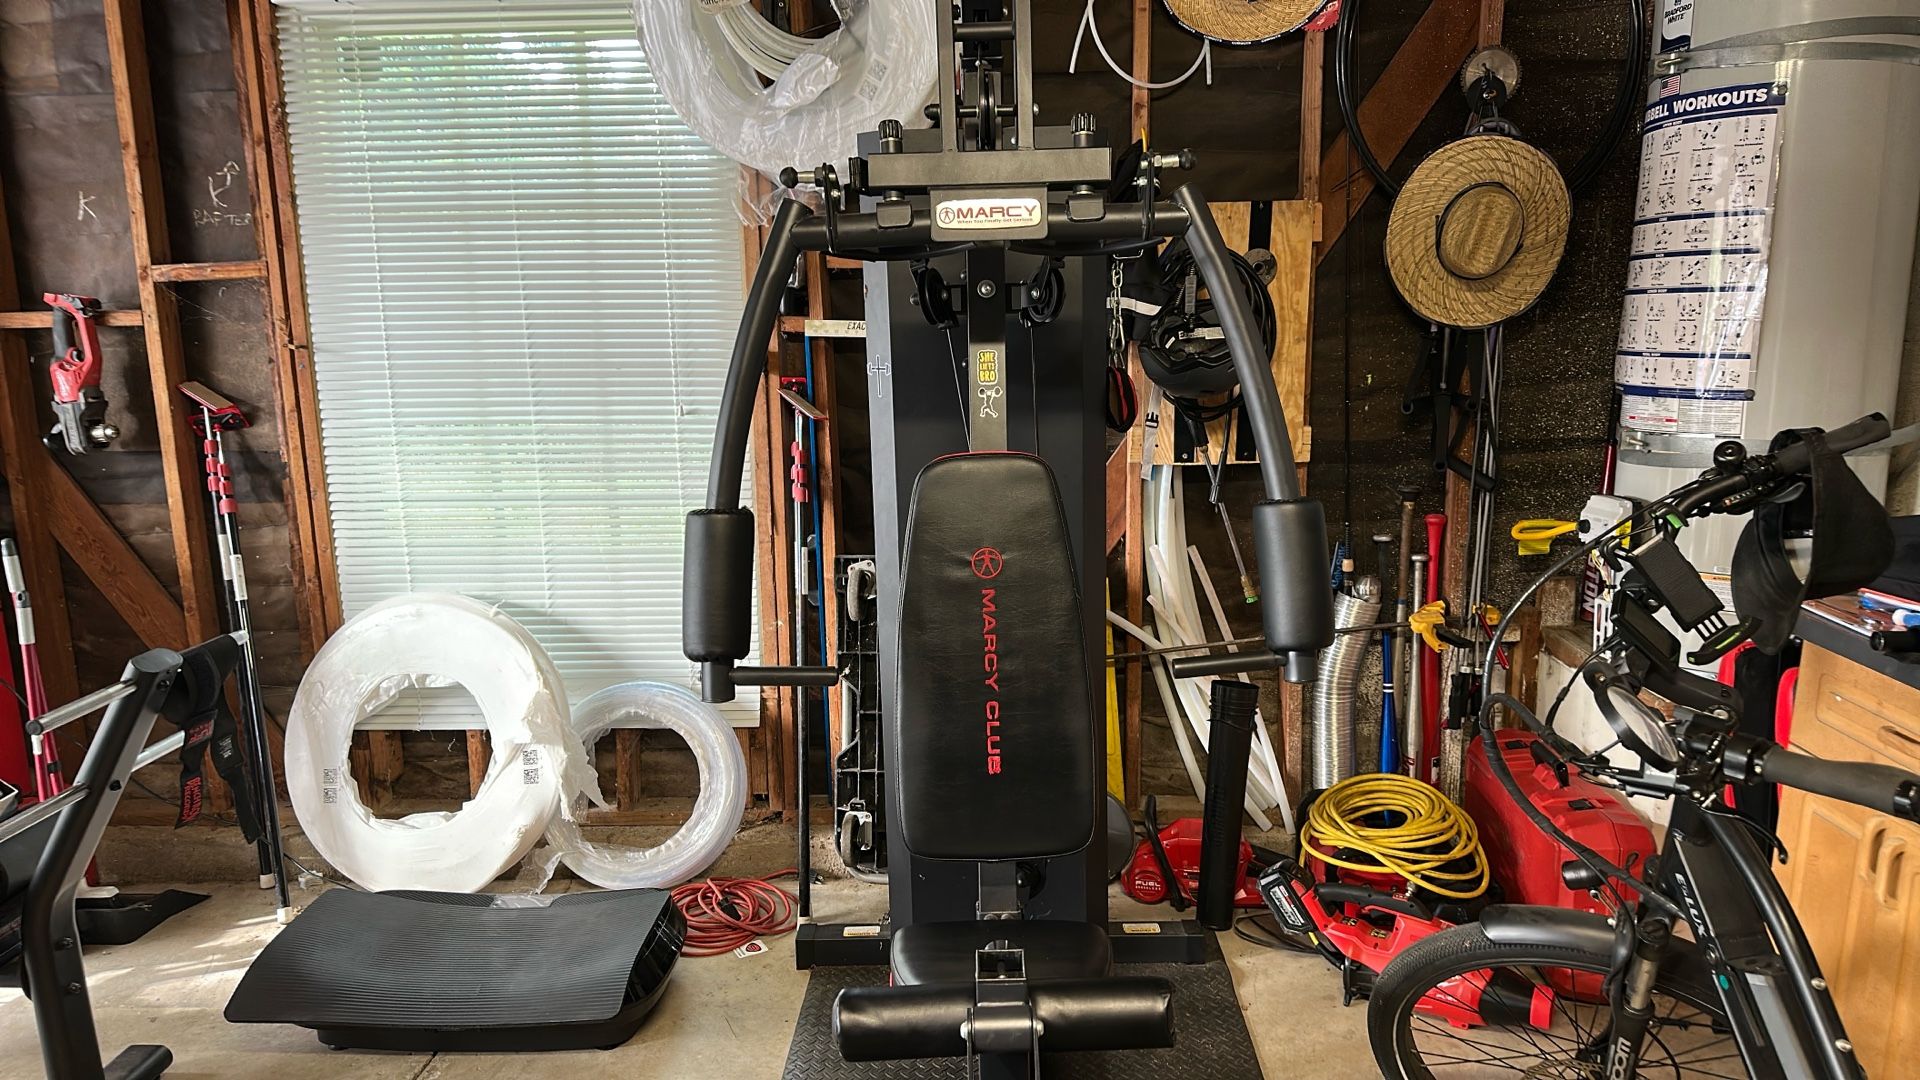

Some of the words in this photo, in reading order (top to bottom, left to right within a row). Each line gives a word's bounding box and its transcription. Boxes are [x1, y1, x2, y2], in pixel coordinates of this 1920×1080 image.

[1673, 88, 1768, 114] WORKOUTS
[77, 191, 99, 222] K
[956, 205, 1037, 219] MARCY
[979, 352, 995, 363] SHE
[980, 370, 996, 382] BRO
[981, 588, 999, 691] MARCY
[986, 700, 1002, 776] CLUB
[1609, 1036, 1632, 1080] OOM
